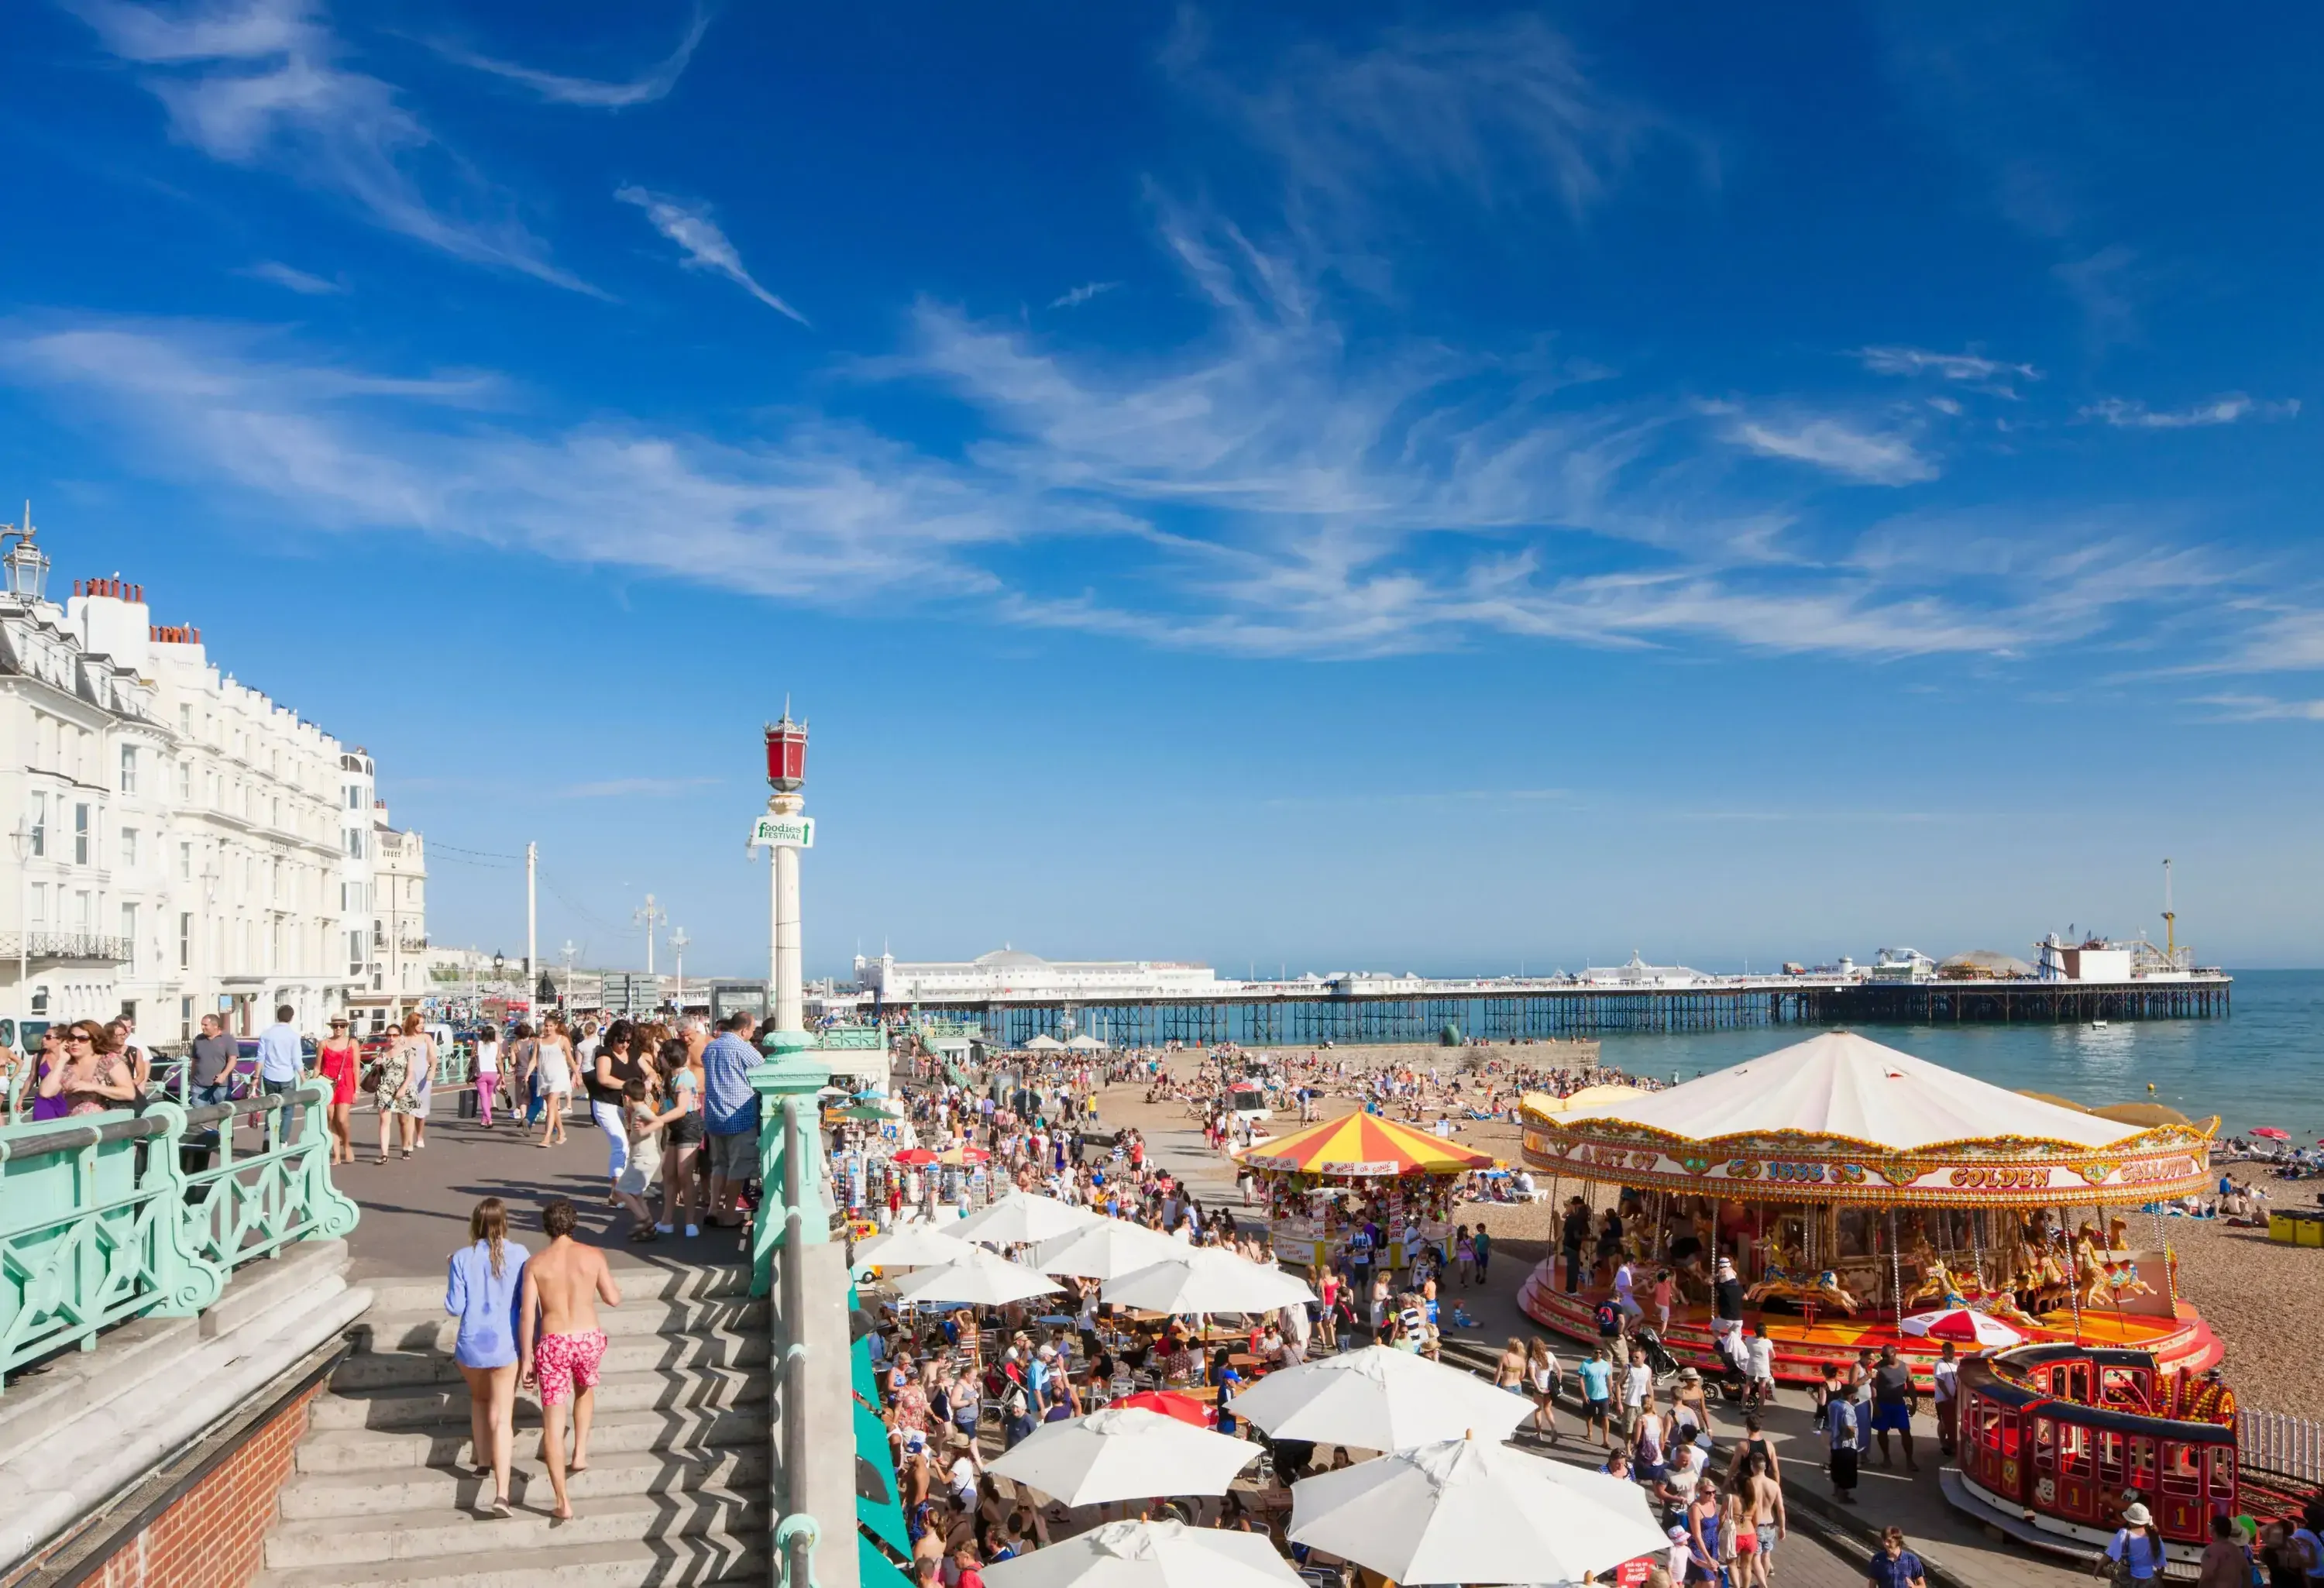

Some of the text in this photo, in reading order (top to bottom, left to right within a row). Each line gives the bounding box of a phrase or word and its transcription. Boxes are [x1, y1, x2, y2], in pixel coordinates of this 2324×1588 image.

[758, 822, 801, 837] foodies
[1336, 1163, 1355, 1174] MARIO
[1372, 1162, 1391, 1174] SONIC
[1631, 1151, 1659, 1170] OF
[1767, 1162, 1825, 1182] 1888
[1950, 1168, 2051, 1187] GOLDEN
[2068, 1488, 2079, 1507] 1
[2173, 1506, 2187, 1528] 1
